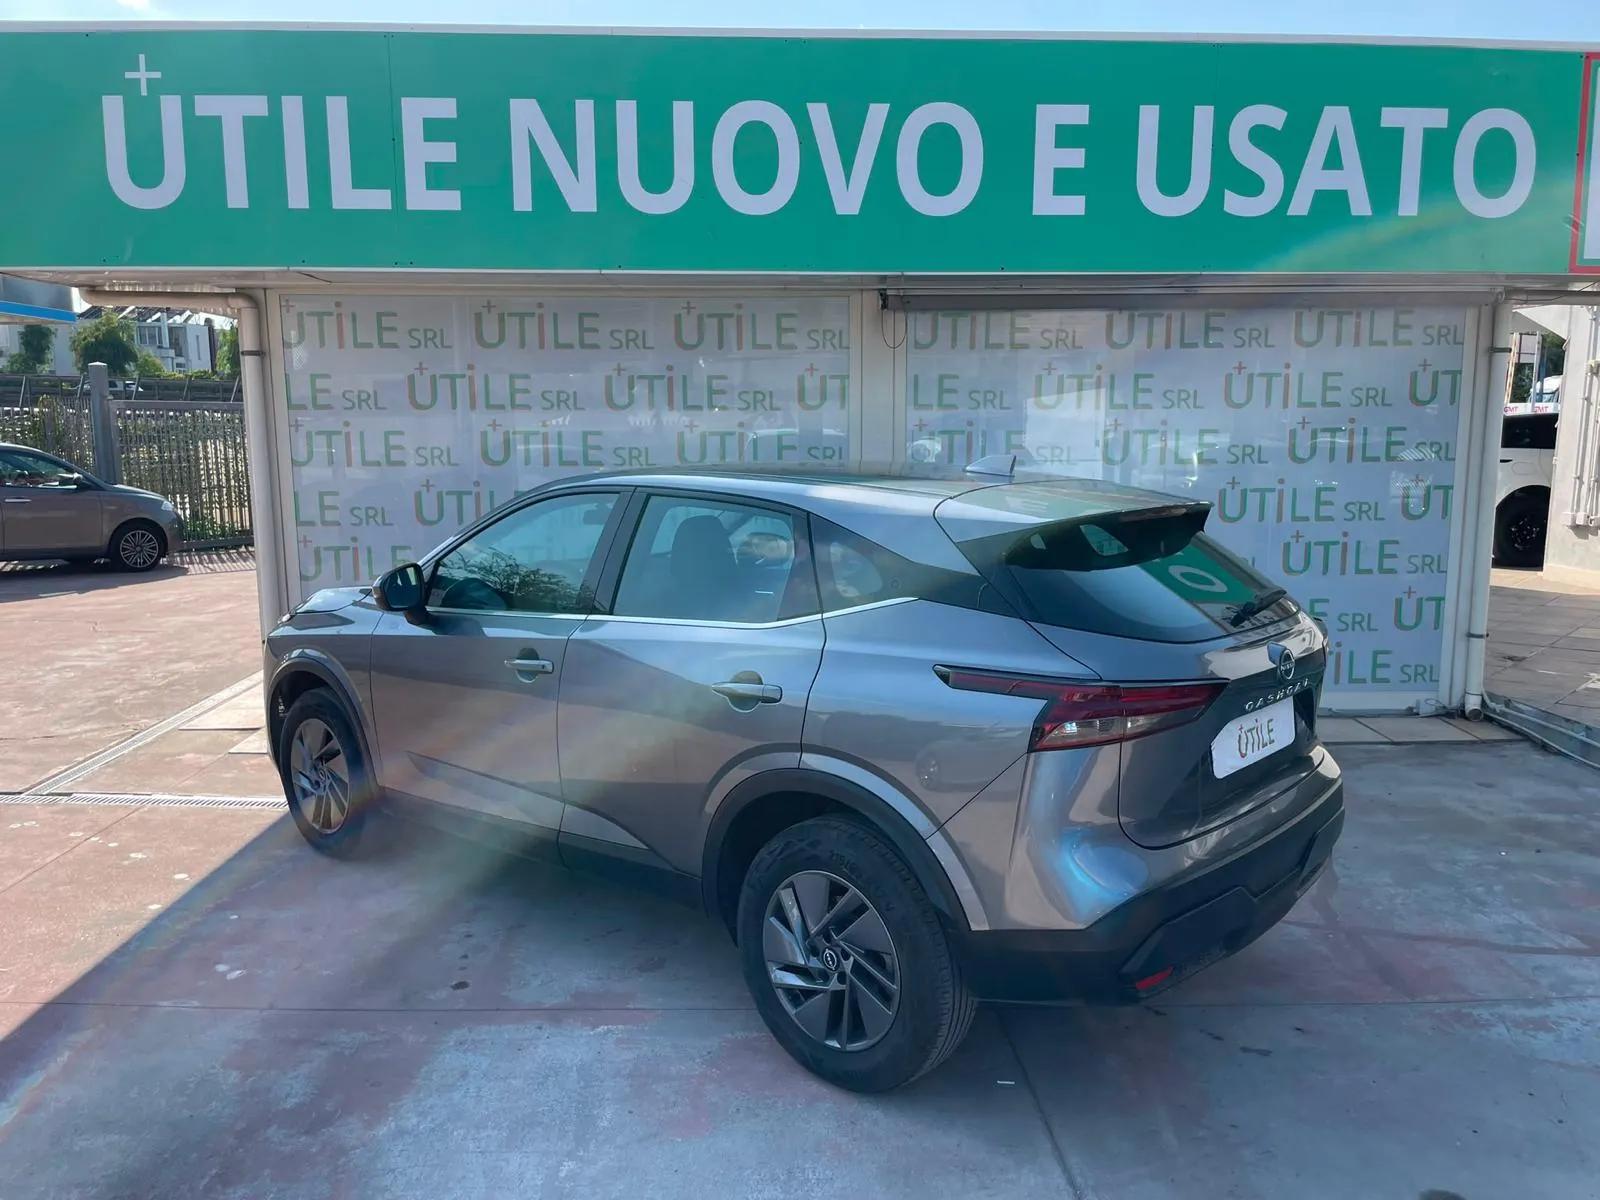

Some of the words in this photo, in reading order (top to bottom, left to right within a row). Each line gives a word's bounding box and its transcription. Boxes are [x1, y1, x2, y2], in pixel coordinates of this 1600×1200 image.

[509, 99, 984, 217] NUOVO
[1032, 104, 1090, 216] E
[1135, 103, 1537, 218] USATO
[408, 328, 453, 349] SRL
[610, 328, 655, 350] SRL
[807, 328, 850, 350] SRL
[1040, 328, 1083, 350] SRL
[1233, 327, 1275, 348] SRL
[1422, 325, 1464, 346] SRL
[342, 389, 387, 410] SRL
[540, 390, 587, 410] SRL
[737, 390, 781, 411] SRL
[968, 390, 1011, 410] SRL
[1162, 389, 1205, 410] SRL
[1350, 387, 1393, 407] SRL
[415, 446, 459, 467] SRL
[613, 446, 657, 467] SRL
[1036, 445, 1077, 465] SRL
[1227, 444, 1269, 464] SRL
[1414, 441, 1455, 461] SRL
[350, 506, 394, 526] SRL
[414, 479, 524, 526] UTi
[1343, 502, 1386, 521] SRL
[1406, 554, 1448, 574] SRL
[1337, 613, 1379, 632] SRL
[1329, 641, 1393, 685] iLE
[1399, 664, 1440, 683] SRL
